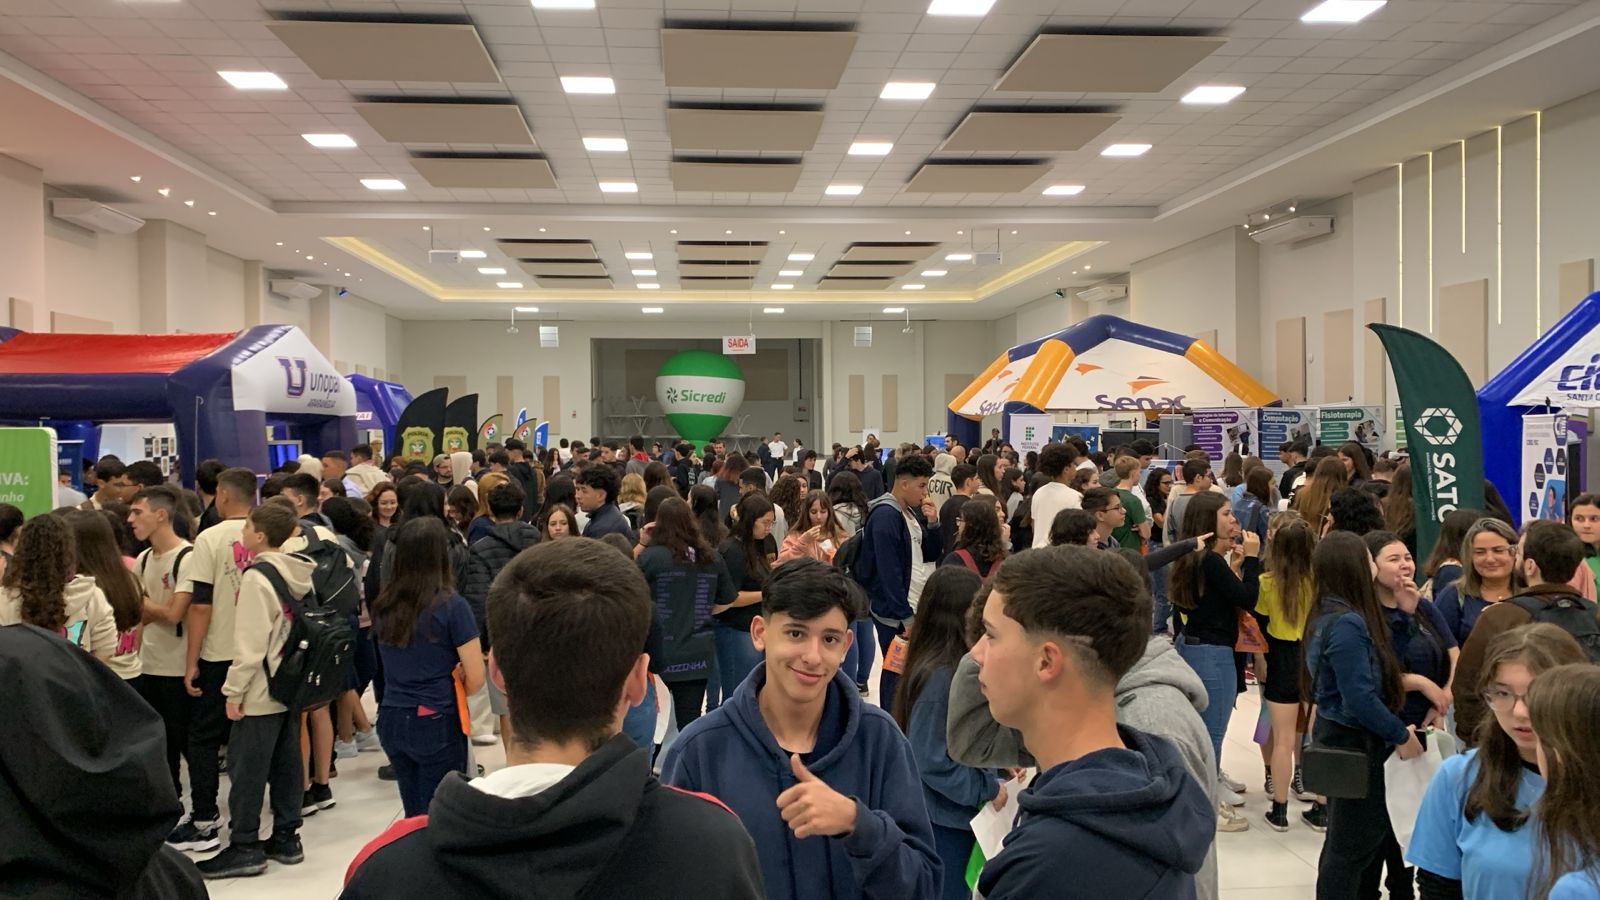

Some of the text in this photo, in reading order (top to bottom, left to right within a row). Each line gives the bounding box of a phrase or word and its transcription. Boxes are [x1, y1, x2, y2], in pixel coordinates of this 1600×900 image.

[680, 389, 727, 404] Sicredi
[1567, 393, 1593, 402] SANTA
[1095, 394, 1185, 411] Senac
[1263, 414, 1299, 424] Computação
[1321, 411, 1362, 420] Fisioterapia
[0, 472, 29, 485] VA:
[0, 491, 25, 502] nho
